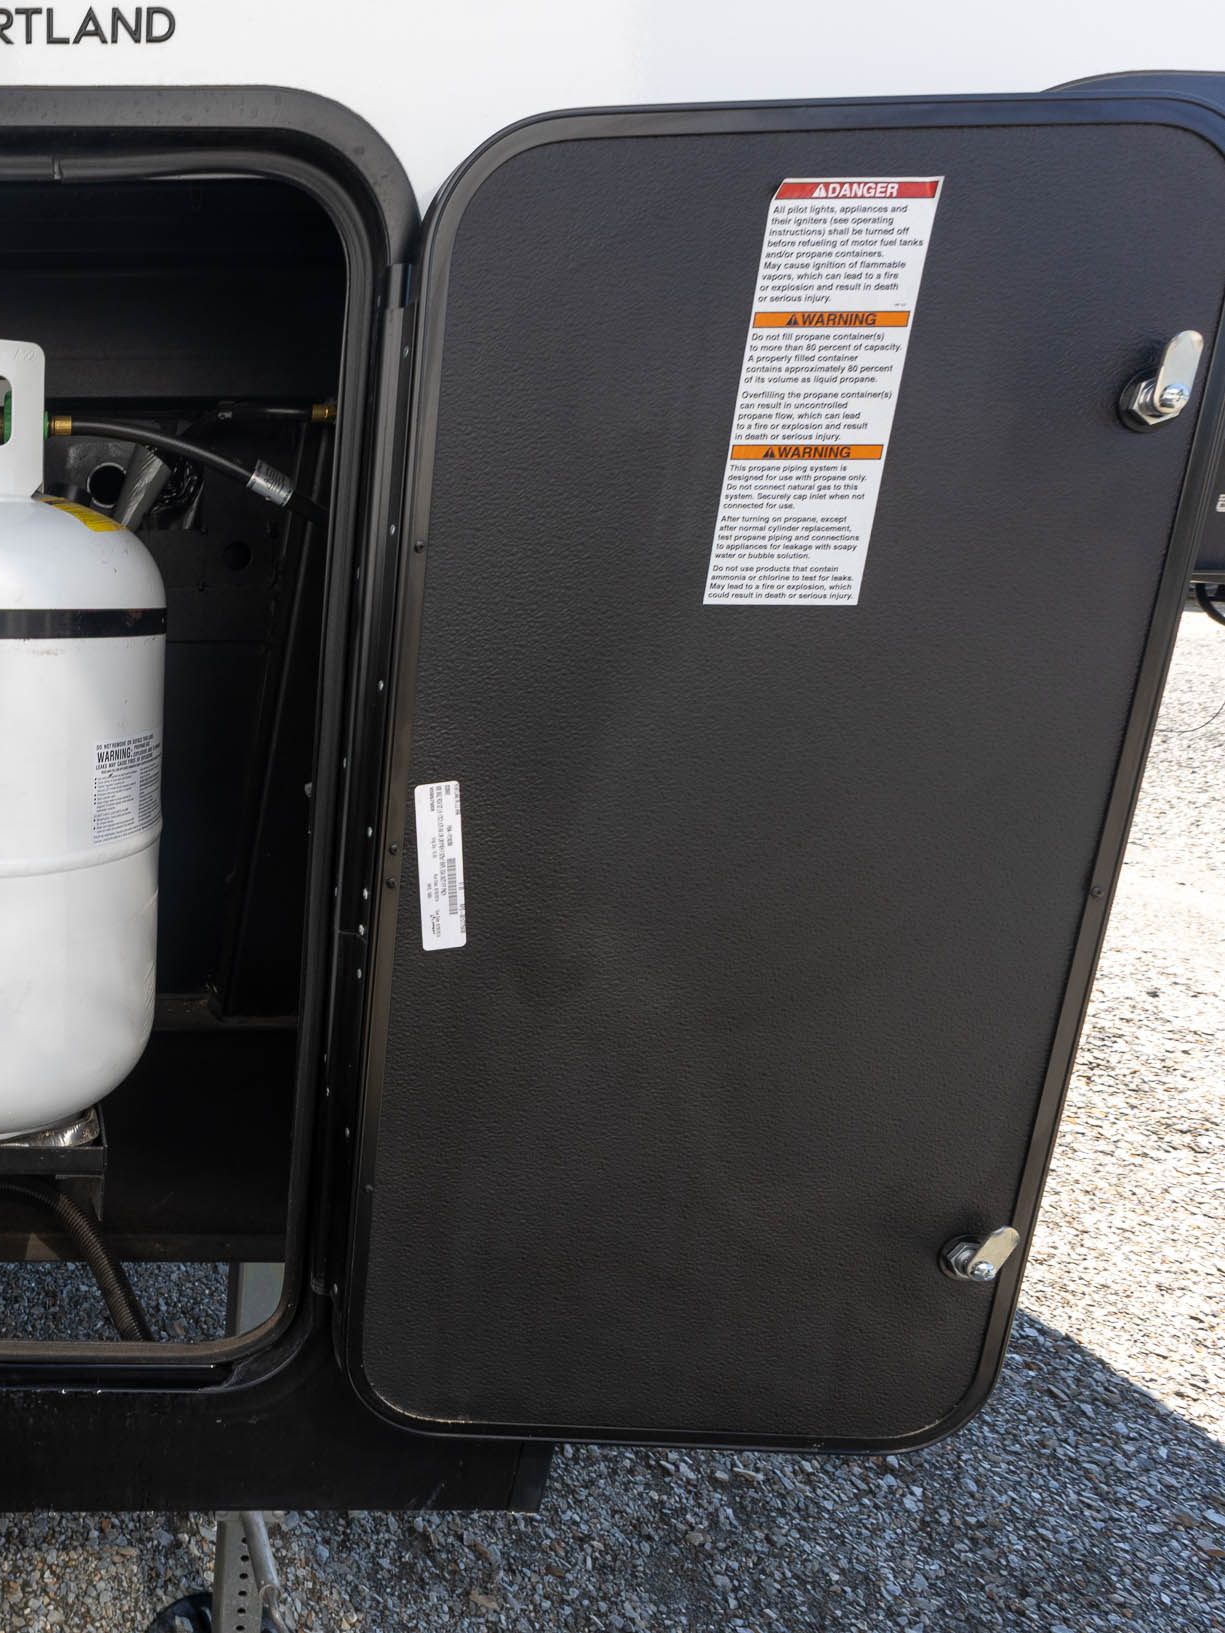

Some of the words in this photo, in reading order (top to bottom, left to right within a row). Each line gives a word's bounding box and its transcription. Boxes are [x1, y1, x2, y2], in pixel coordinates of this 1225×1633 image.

[826, 183, 898, 197] DANGER
[773, 206, 784, 214] All
[787, 206, 807, 214] pilot
[810, 206, 836, 214] lights,
[840, 206, 888, 214] appliances
[891, 205, 908, 213] and
[794, 217, 827, 226] igniters
[830, 217, 848, 225] (see
[851, 217, 894, 225] operating
[769, 228, 826, 237] instructions)
[828, 228, 849, 236] shall
[852, 228, 862, 236] be
[865, 228, 894, 236] turned
[896, 227, 909, 235] off
[768, 240, 795, 248] before
[798, 239, 838, 248] refueling
[796, 251, 833, 259] propane
[835, 250, 884, 258] containers.
[764, 262, 782, 270] May
[784, 262, 810, 270] cause
[812, 261, 846, 270] ignition
[848, 261, 858, 269] of
[844, 272, 862, 280] lead
[865, 272, 874, 280] to
[884, 272, 899, 280] fire
[771, 284, 814, 292] explosion
[816, 283, 833, 291] and
[836, 283, 861, 291] result
[804, 294, 831, 303] injury.
[802, 313, 876, 326] WARNING
[782, 333, 793, 341] fill
[795, 334, 830, 342] propane
[832, 332, 885, 341] container(s)
[818, 344, 850, 352] percent
[864, 343, 902, 352] capacity.
[756, 355, 792, 363] properly
[794, 354, 815, 362] filled
[784, 365, 846, 374] approximately
[860, 365, 893, 373] percent
[814, 376, 837, 384] liquid
[839, 376, 878, 384] propane.
[742, 392, 785, 400] Overfilling
[803, 392, 839, 400] propane
[841, 391, 892, 399] container(s)
[775, 412, 794, 420] flow,
[781, 423, 823, 431] explosion
[778, 447, 851, 458] WARNING
[782, 465, 807, 473] piping
[848, 474, 867, 482] only.
[757, 493, 791, 501] Securely
[784, 516, 818, 524] propane,
[829, 592, 853, 600] injury.
